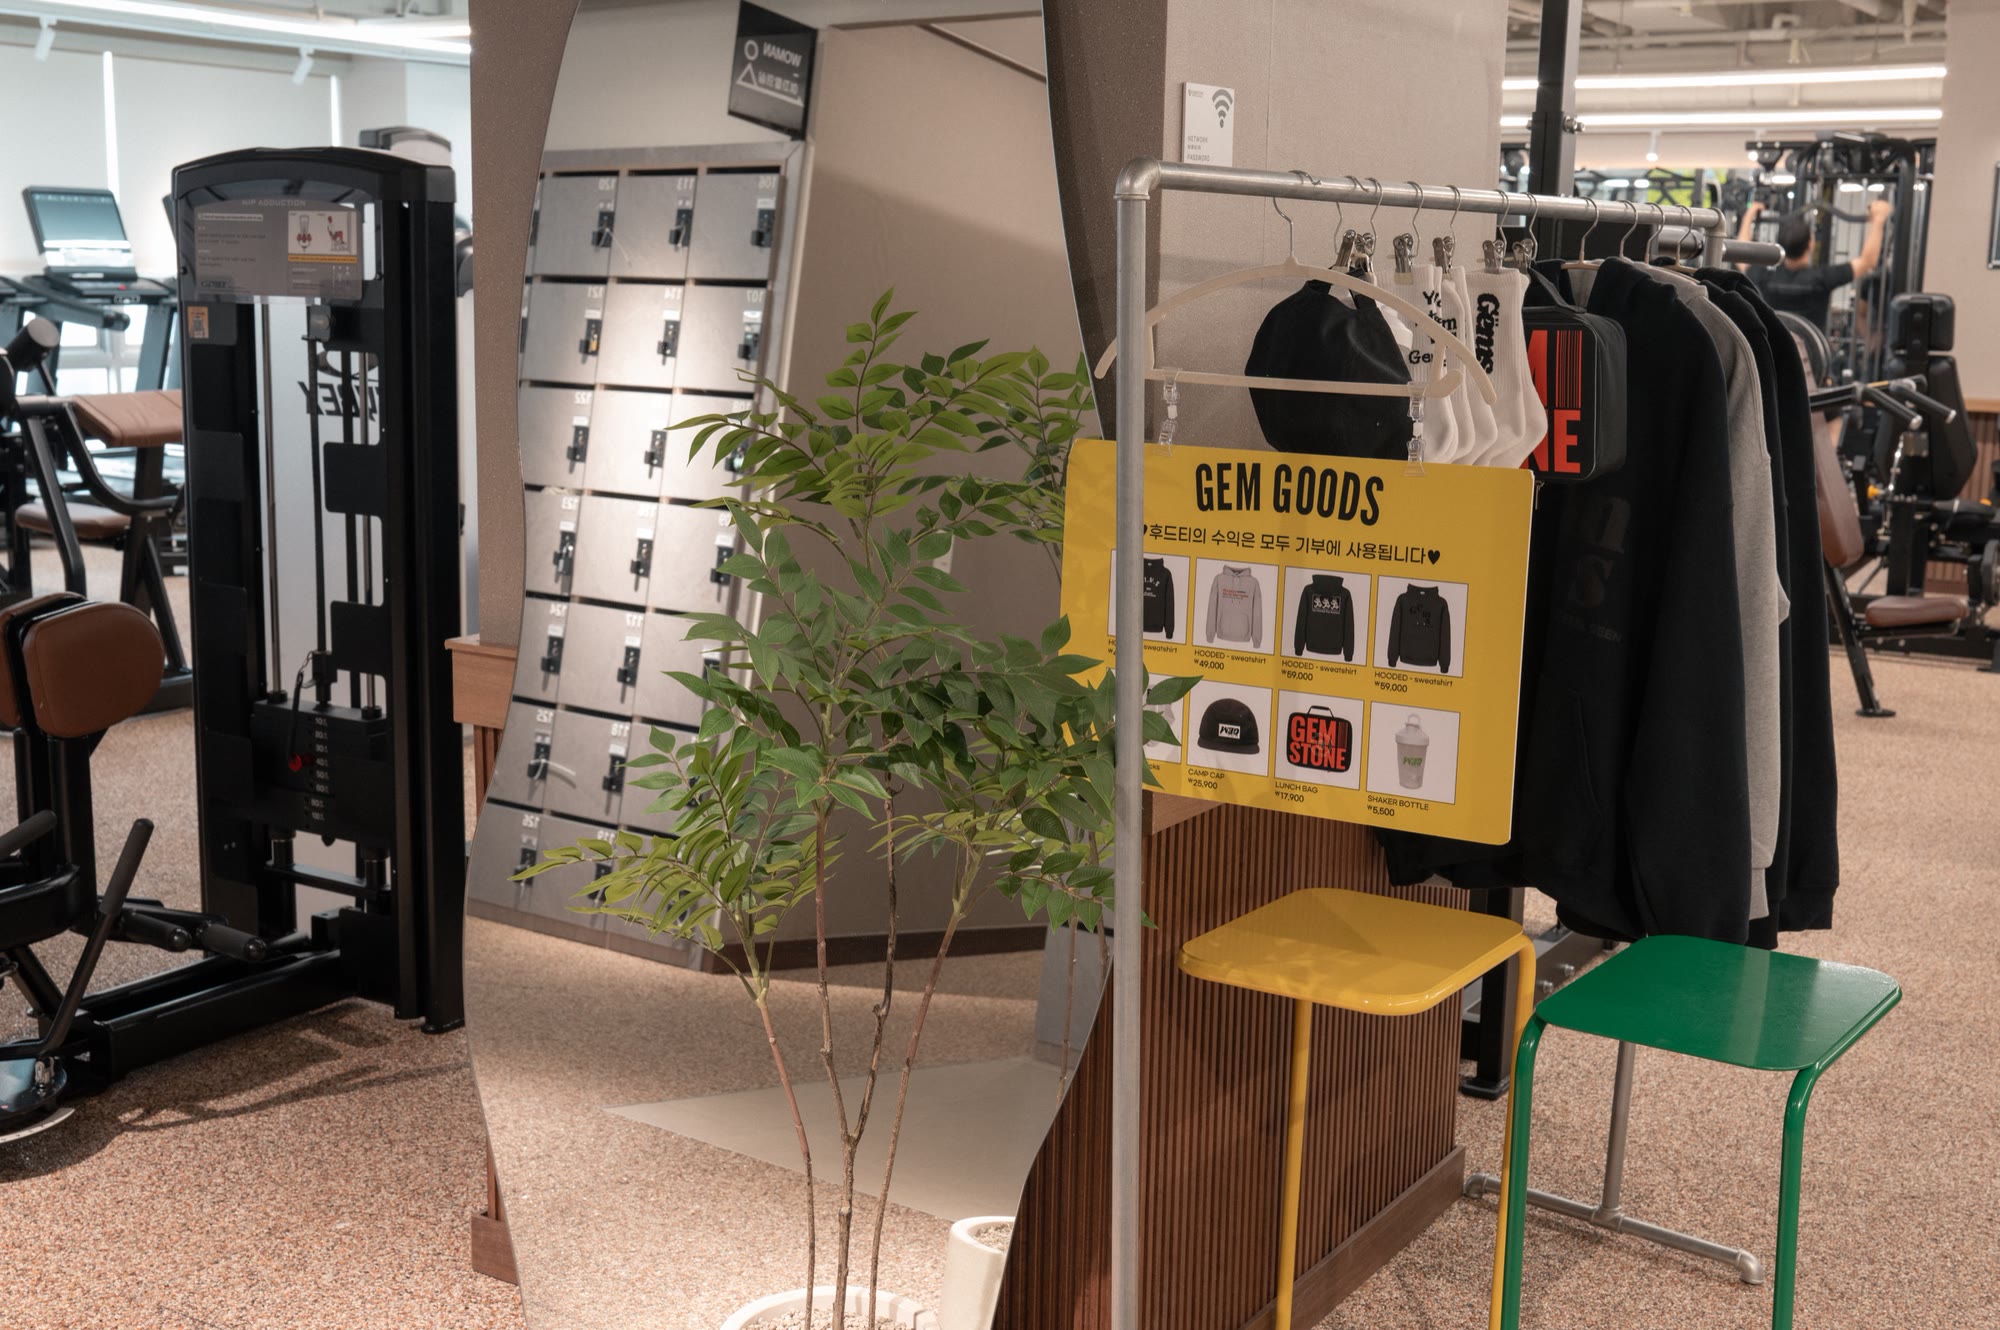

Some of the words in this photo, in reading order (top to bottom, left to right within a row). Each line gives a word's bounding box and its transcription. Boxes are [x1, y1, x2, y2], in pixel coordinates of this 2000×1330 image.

[1195, 462, 1261, 512] GEM
[1273, 464, 1384, 526] GOODS
[1149, 523, 1206, 545] 후드티의
[1211, 529, 1256, 549] 수익은
[1260, 534, 1290, 552] 모두
[1295, 536, 1341, 557] 기부에
[1346, 541, 1426, 564] 사용됩니다
[1194, 650, 1226, 660] HOODED
[1231, 654, 1266, 665] sweatshirt
[1281, 660, 1314, 670] HOODED
[1320, 666, 1357, 676] sweatshirt
[1374, 671, 1408, 682] HOODED
[1414, 676, 1453, 687] sweatshirt
[1291, 715, 1337, 747] GEM
[1289, 741, 1347, 770] STONE
[1188, 768, 1209, 777] CAMP
[1209, 771, 1225, 780] CAP
[1275, 781, 1301, 792] LUNCH
[1302, 784, 1318, 794] BAG
[1367, 795, 1398, 806] SHAKER
[1399, 799, 1429, 811] BOTTLE
